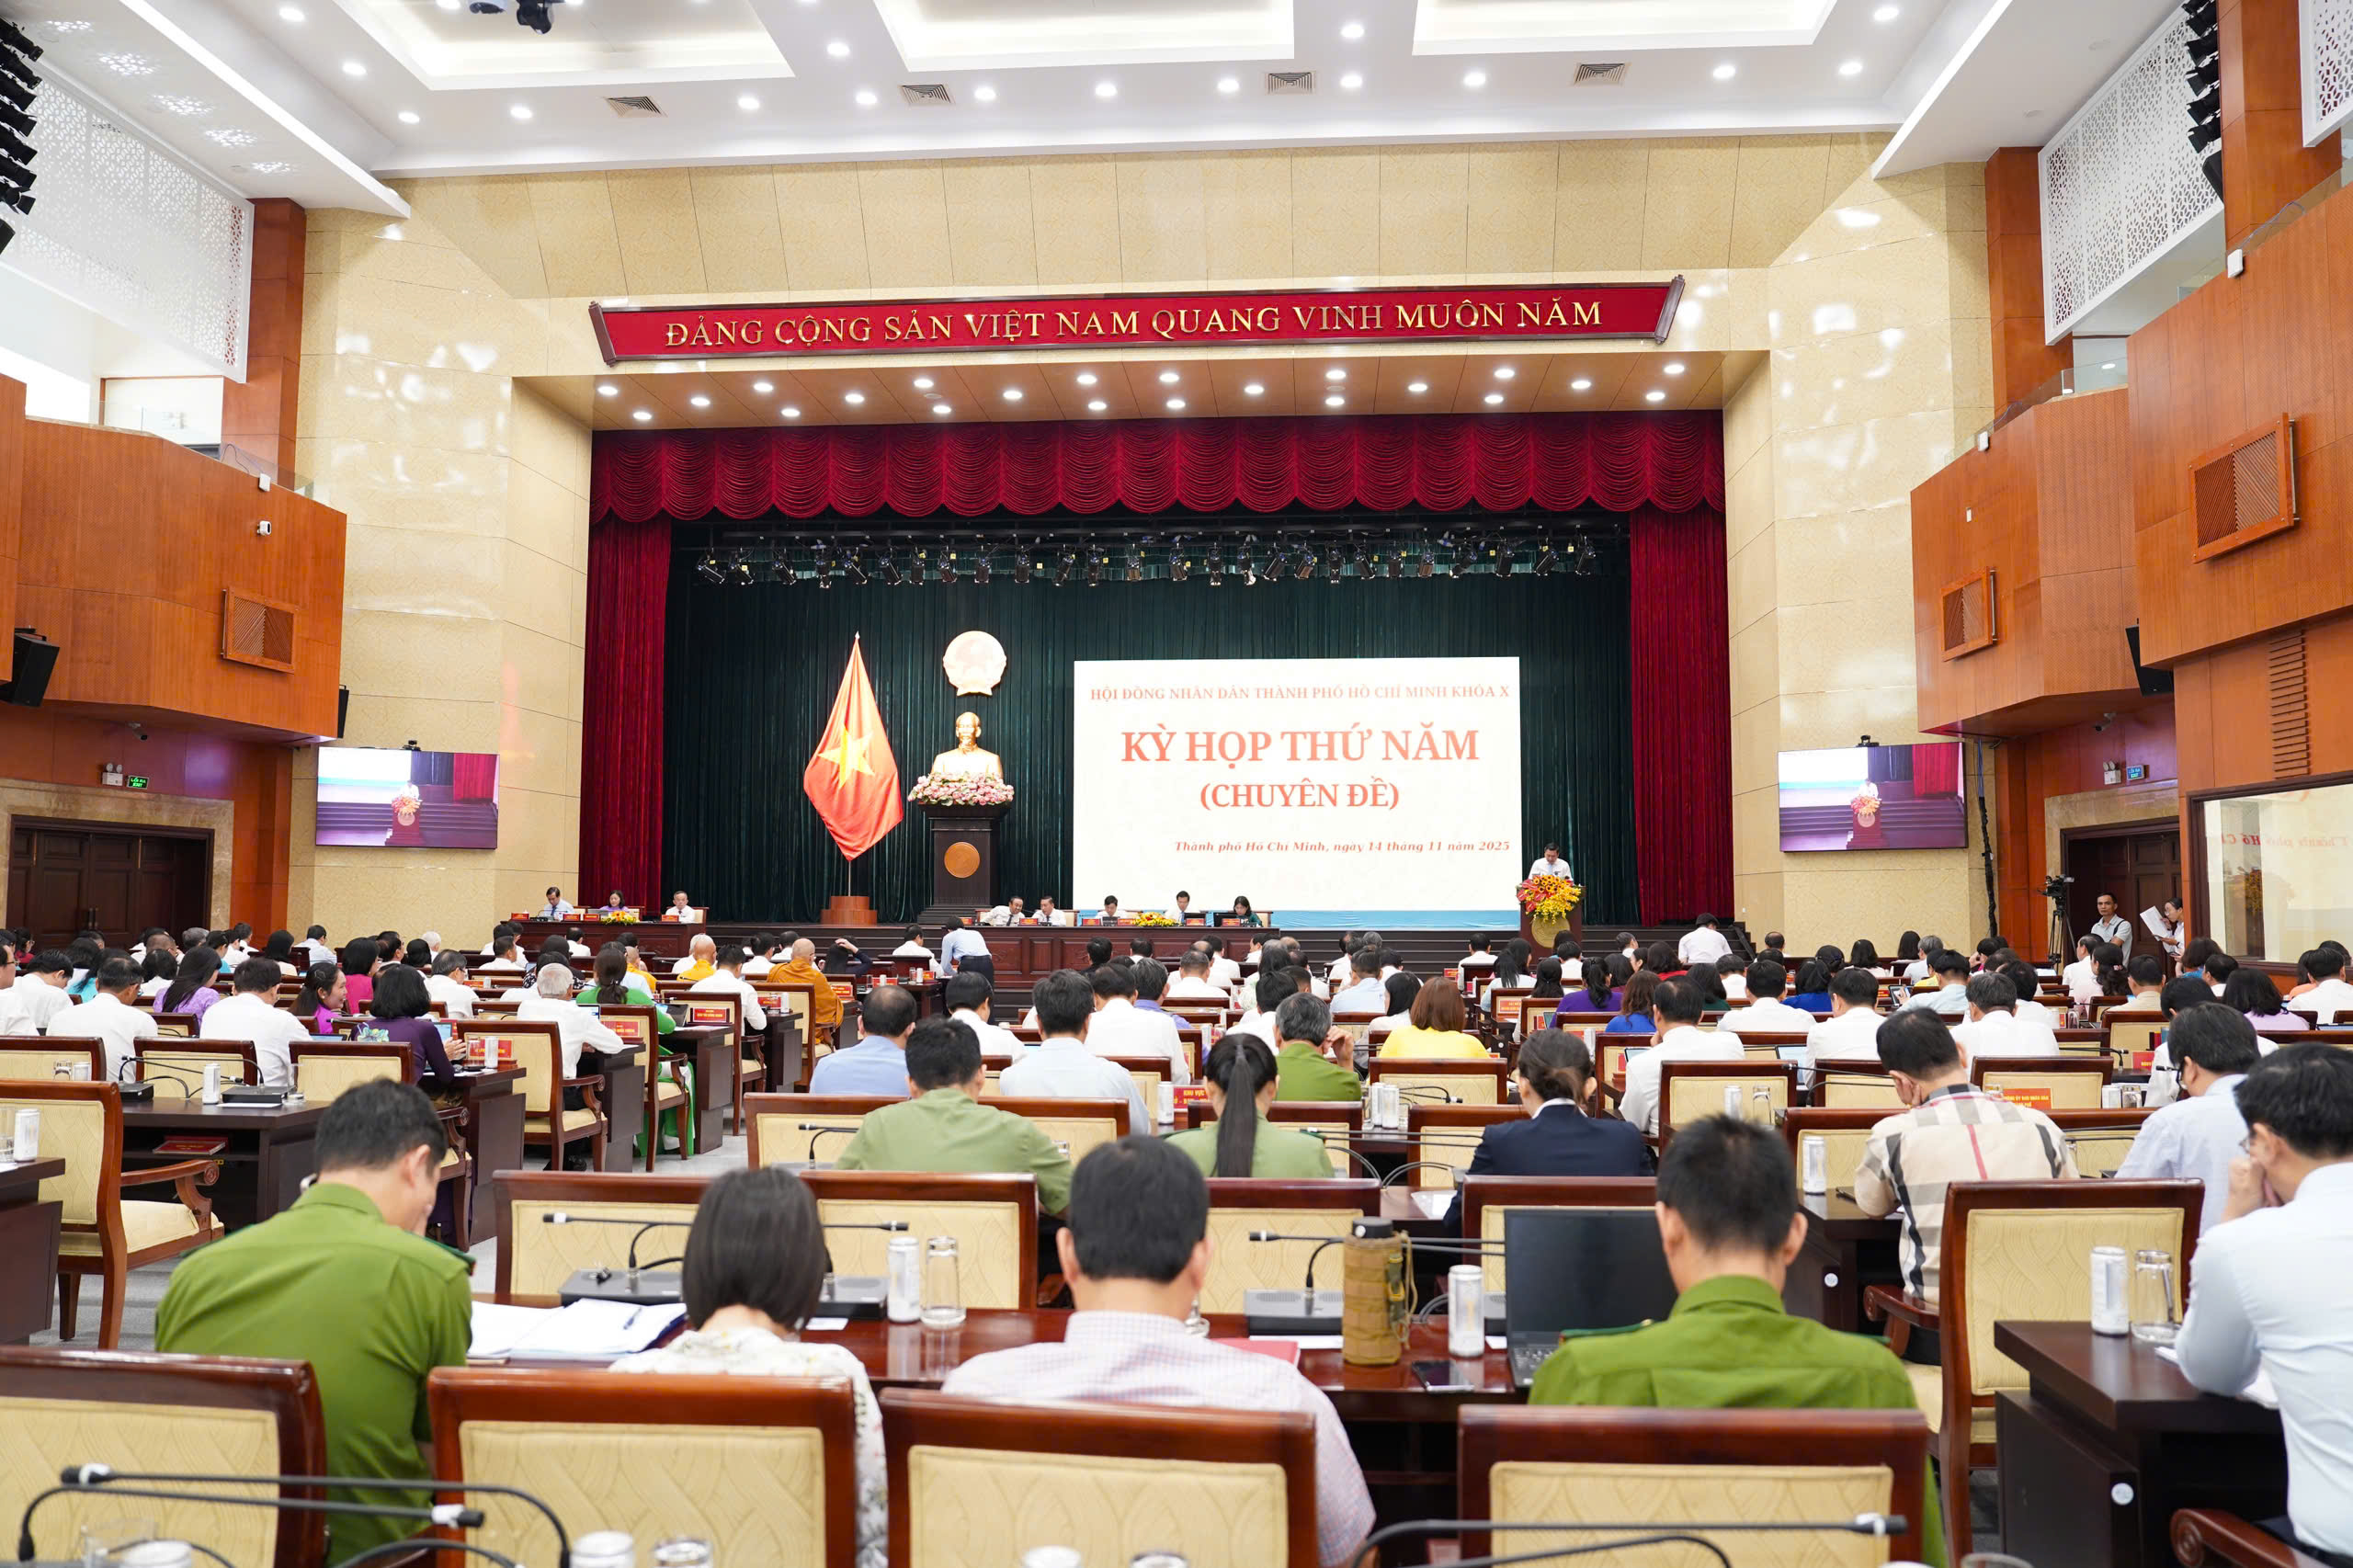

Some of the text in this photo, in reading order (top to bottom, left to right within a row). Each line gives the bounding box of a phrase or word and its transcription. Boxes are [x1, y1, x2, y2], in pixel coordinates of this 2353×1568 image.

[665, 295, 1603, 347] ĐẢNG CỘNG SẢN VIỆT NAM QUANG VINH MUÔN NĂM
[1091, 683, 1510, 702] HỘI ĐỒNG NHÂN DÂN THÀNH PHỐ HỒ CHÍ MINH KHÓA X
[1121, 721, 1481, 770] KỲ HỌP THỨ NĂM
[1199, 775, 1400, 811] (CHUYÊN ĐỀ)
[1176, 840, 1510, 854] Thành phố Hồ Chí Minh, ngày 14 tháng 11 năm 2025
